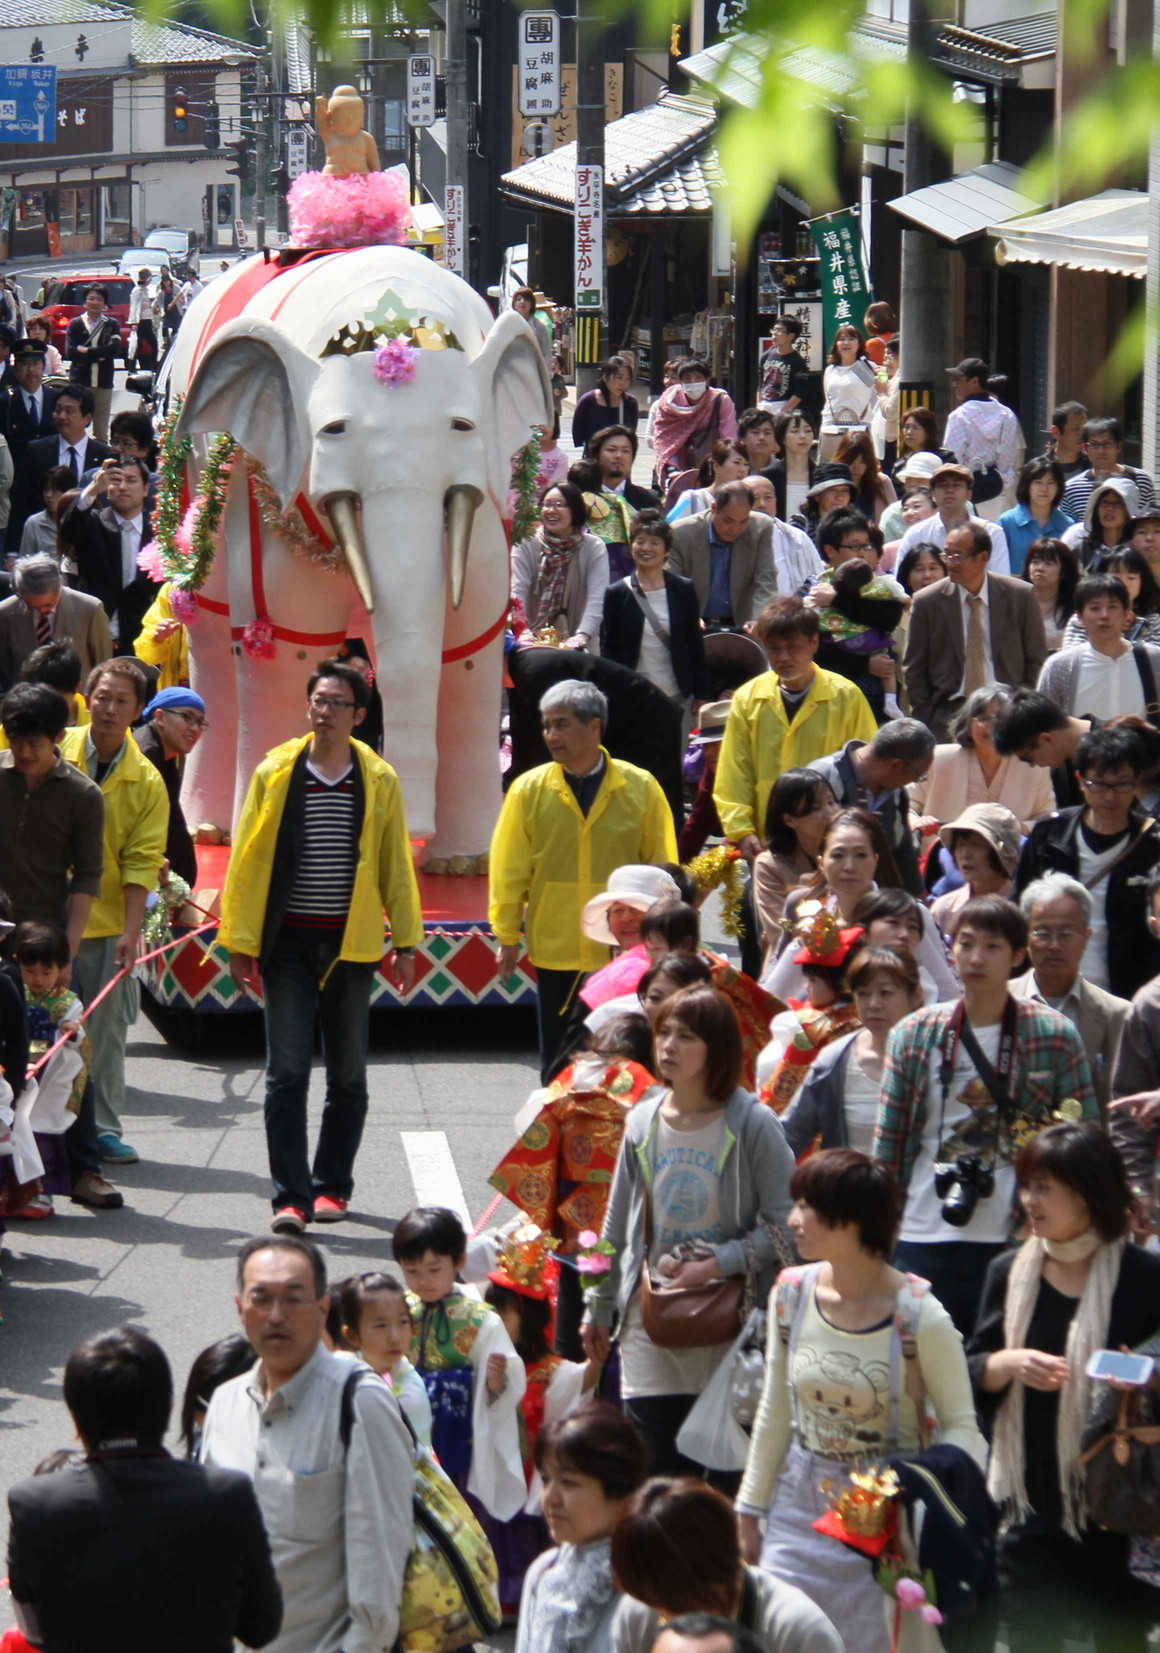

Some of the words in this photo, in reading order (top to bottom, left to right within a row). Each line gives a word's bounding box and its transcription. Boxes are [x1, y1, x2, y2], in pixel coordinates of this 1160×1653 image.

[525, 57, 539, 90] 豆腐
[541, 51, 554, 84] 胡麻
[57, 107, 87, 127] そば
[577, 168, 592, 288] すりこぎ羊かん
[823, 231, 853, 328] 福井県産
